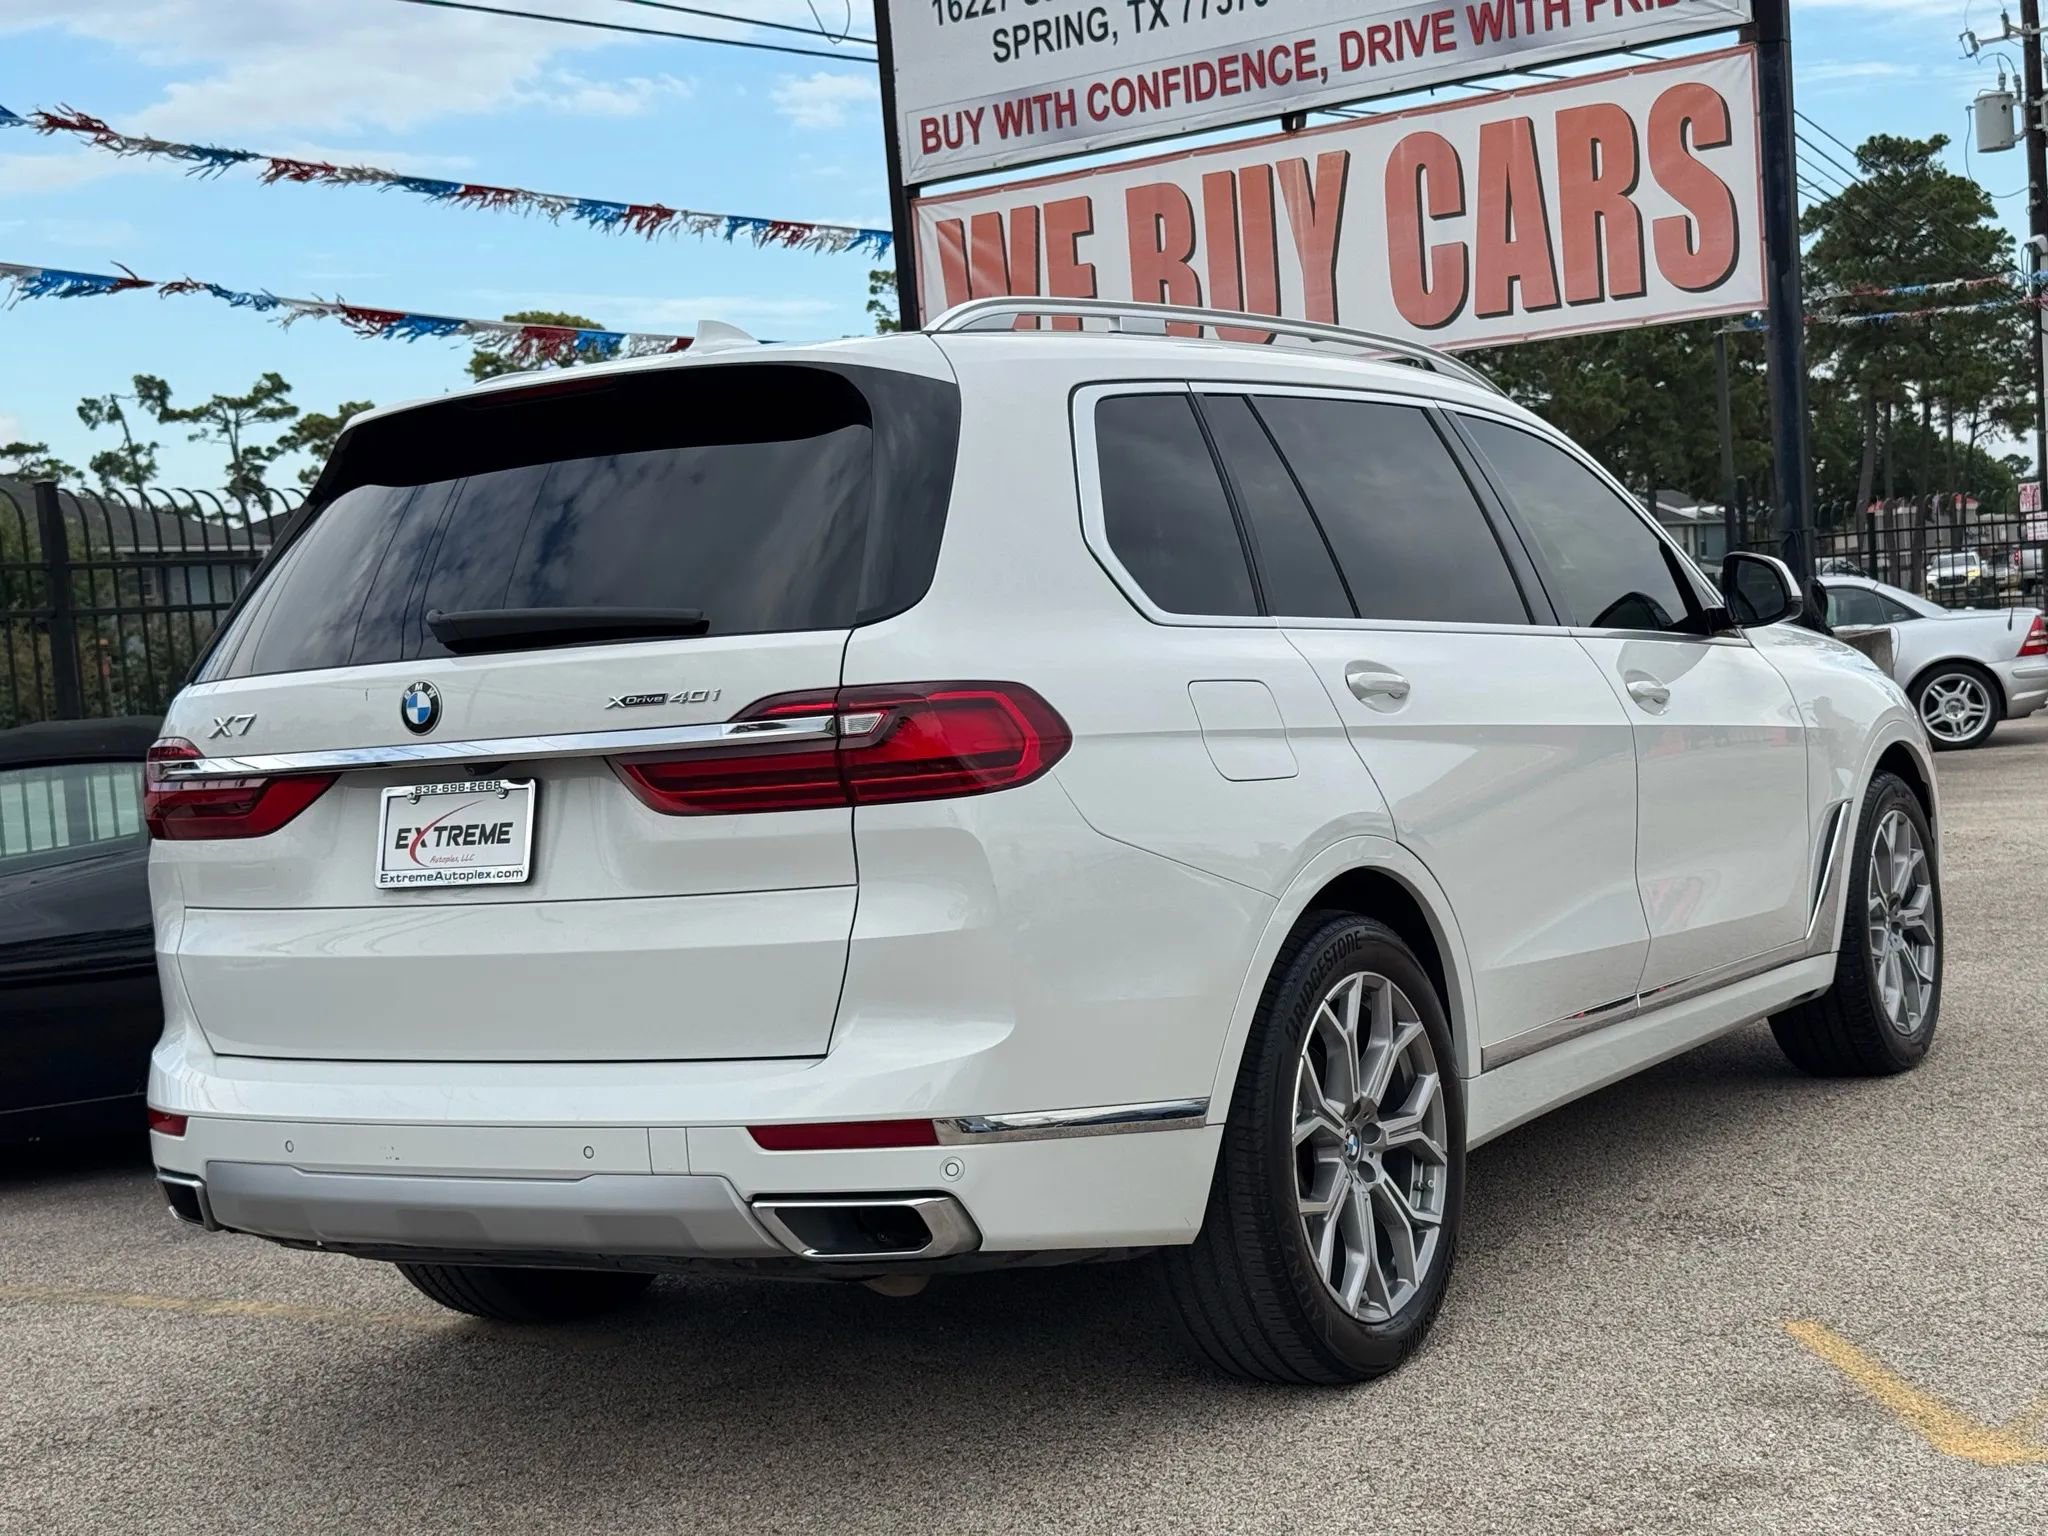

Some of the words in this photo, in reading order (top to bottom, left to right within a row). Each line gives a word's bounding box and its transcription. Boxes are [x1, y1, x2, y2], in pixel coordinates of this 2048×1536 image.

[993, 7, 1118, 63] SPRING,
[1127, 0, 1170, 34] TX
[920, 107, 985, 155] BUY
[993, 88, 1077, 141] WITH
[1086, 39, 1328, 122] CONFIDENCE,
[1339, 9, 1457, 72] DRIVE
[1471, 0, 1571, 46] WITH
[936, 195, 1095, 332] WE
[1125, 150, 1349, 345] BUY
[1384, 82, 1740, 330] CARS
[207, 713, 257, 740] X7
[395, 822, 513, 850] EXTREME
[380, 869, 523, 884] ExtremeAutoplex.com
